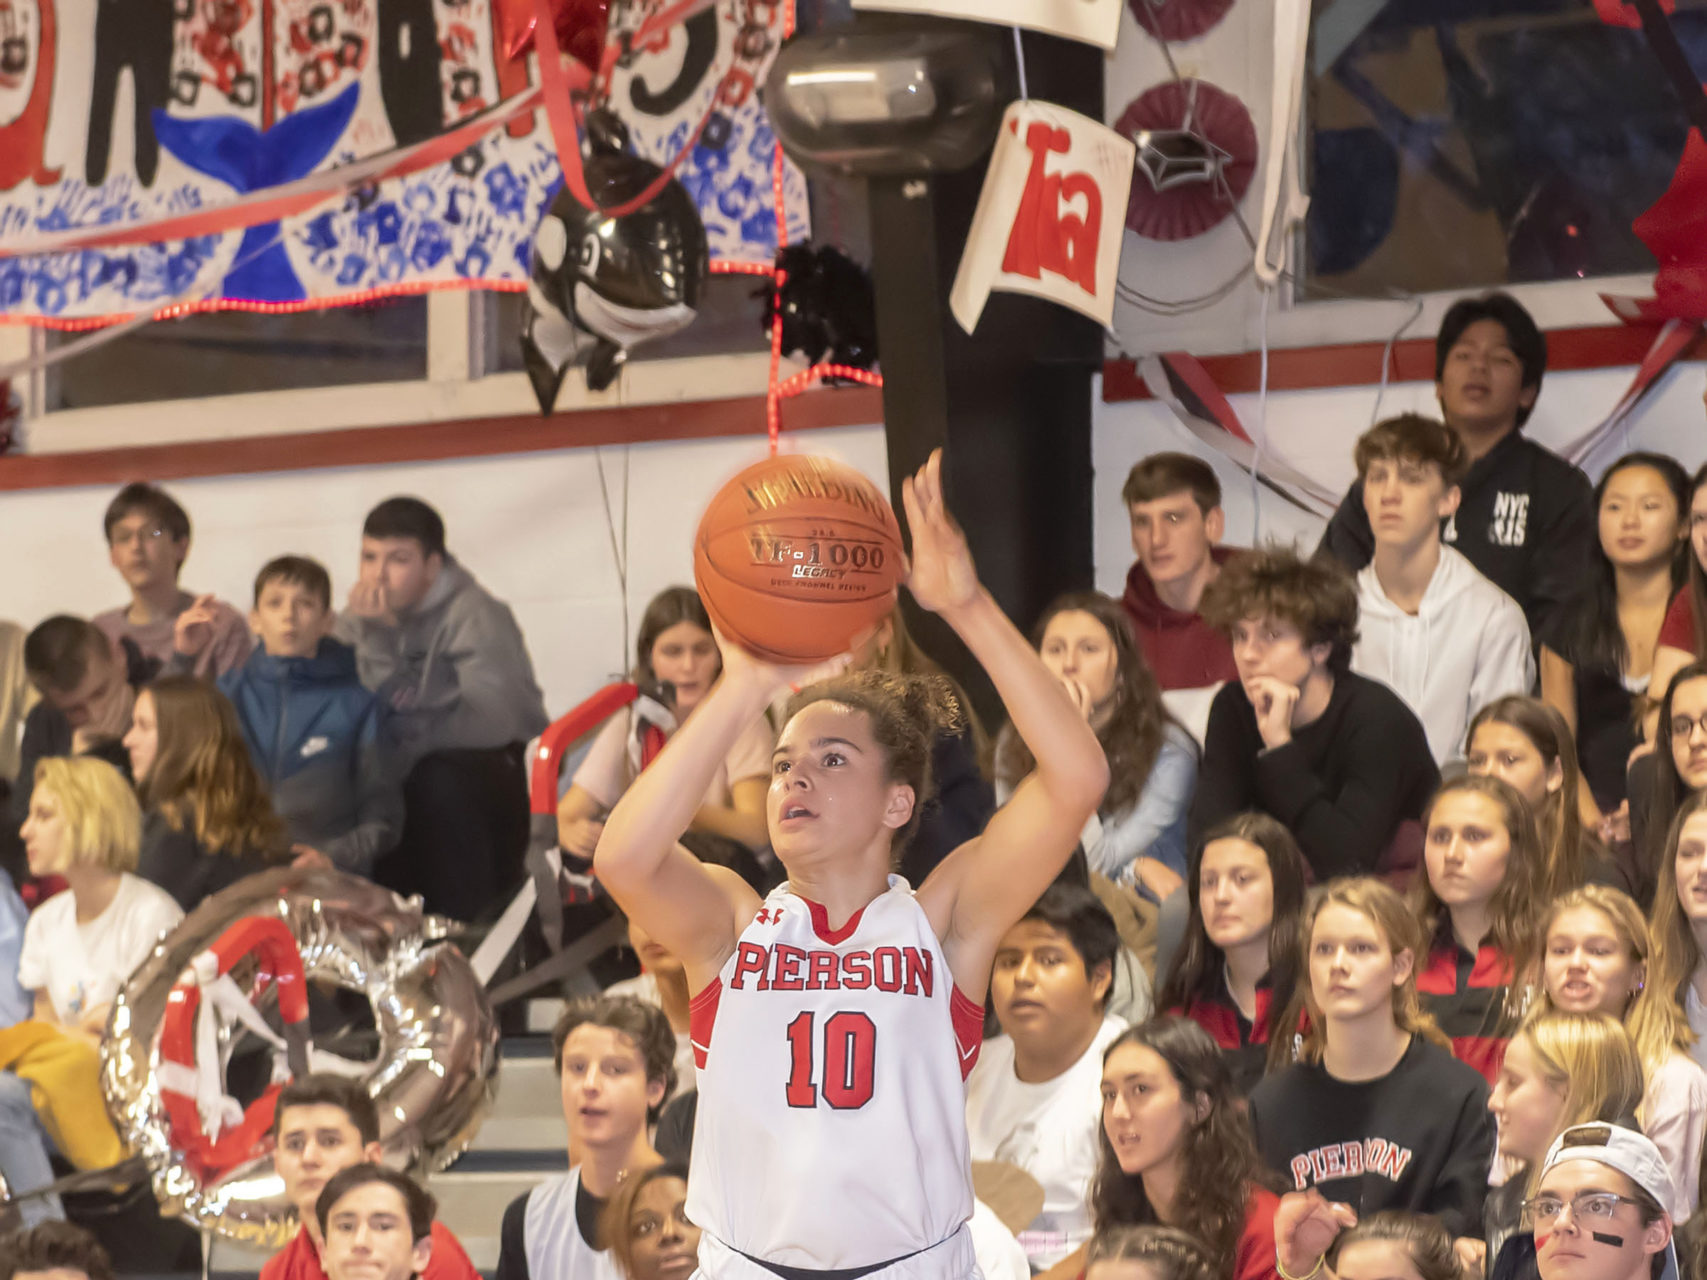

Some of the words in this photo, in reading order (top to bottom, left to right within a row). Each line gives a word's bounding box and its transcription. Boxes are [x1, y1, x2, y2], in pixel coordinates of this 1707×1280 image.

[1494, 490, 1530, 518] NYC
[750, 535, 885, 570] TF-1000
[792, 564, 848, 580] LEGACY
[731, 941, 934, 998] PIERSON
[785, 1010, 877, 1110] 10
[1290, 1137, 1412, 1191] PIERON
